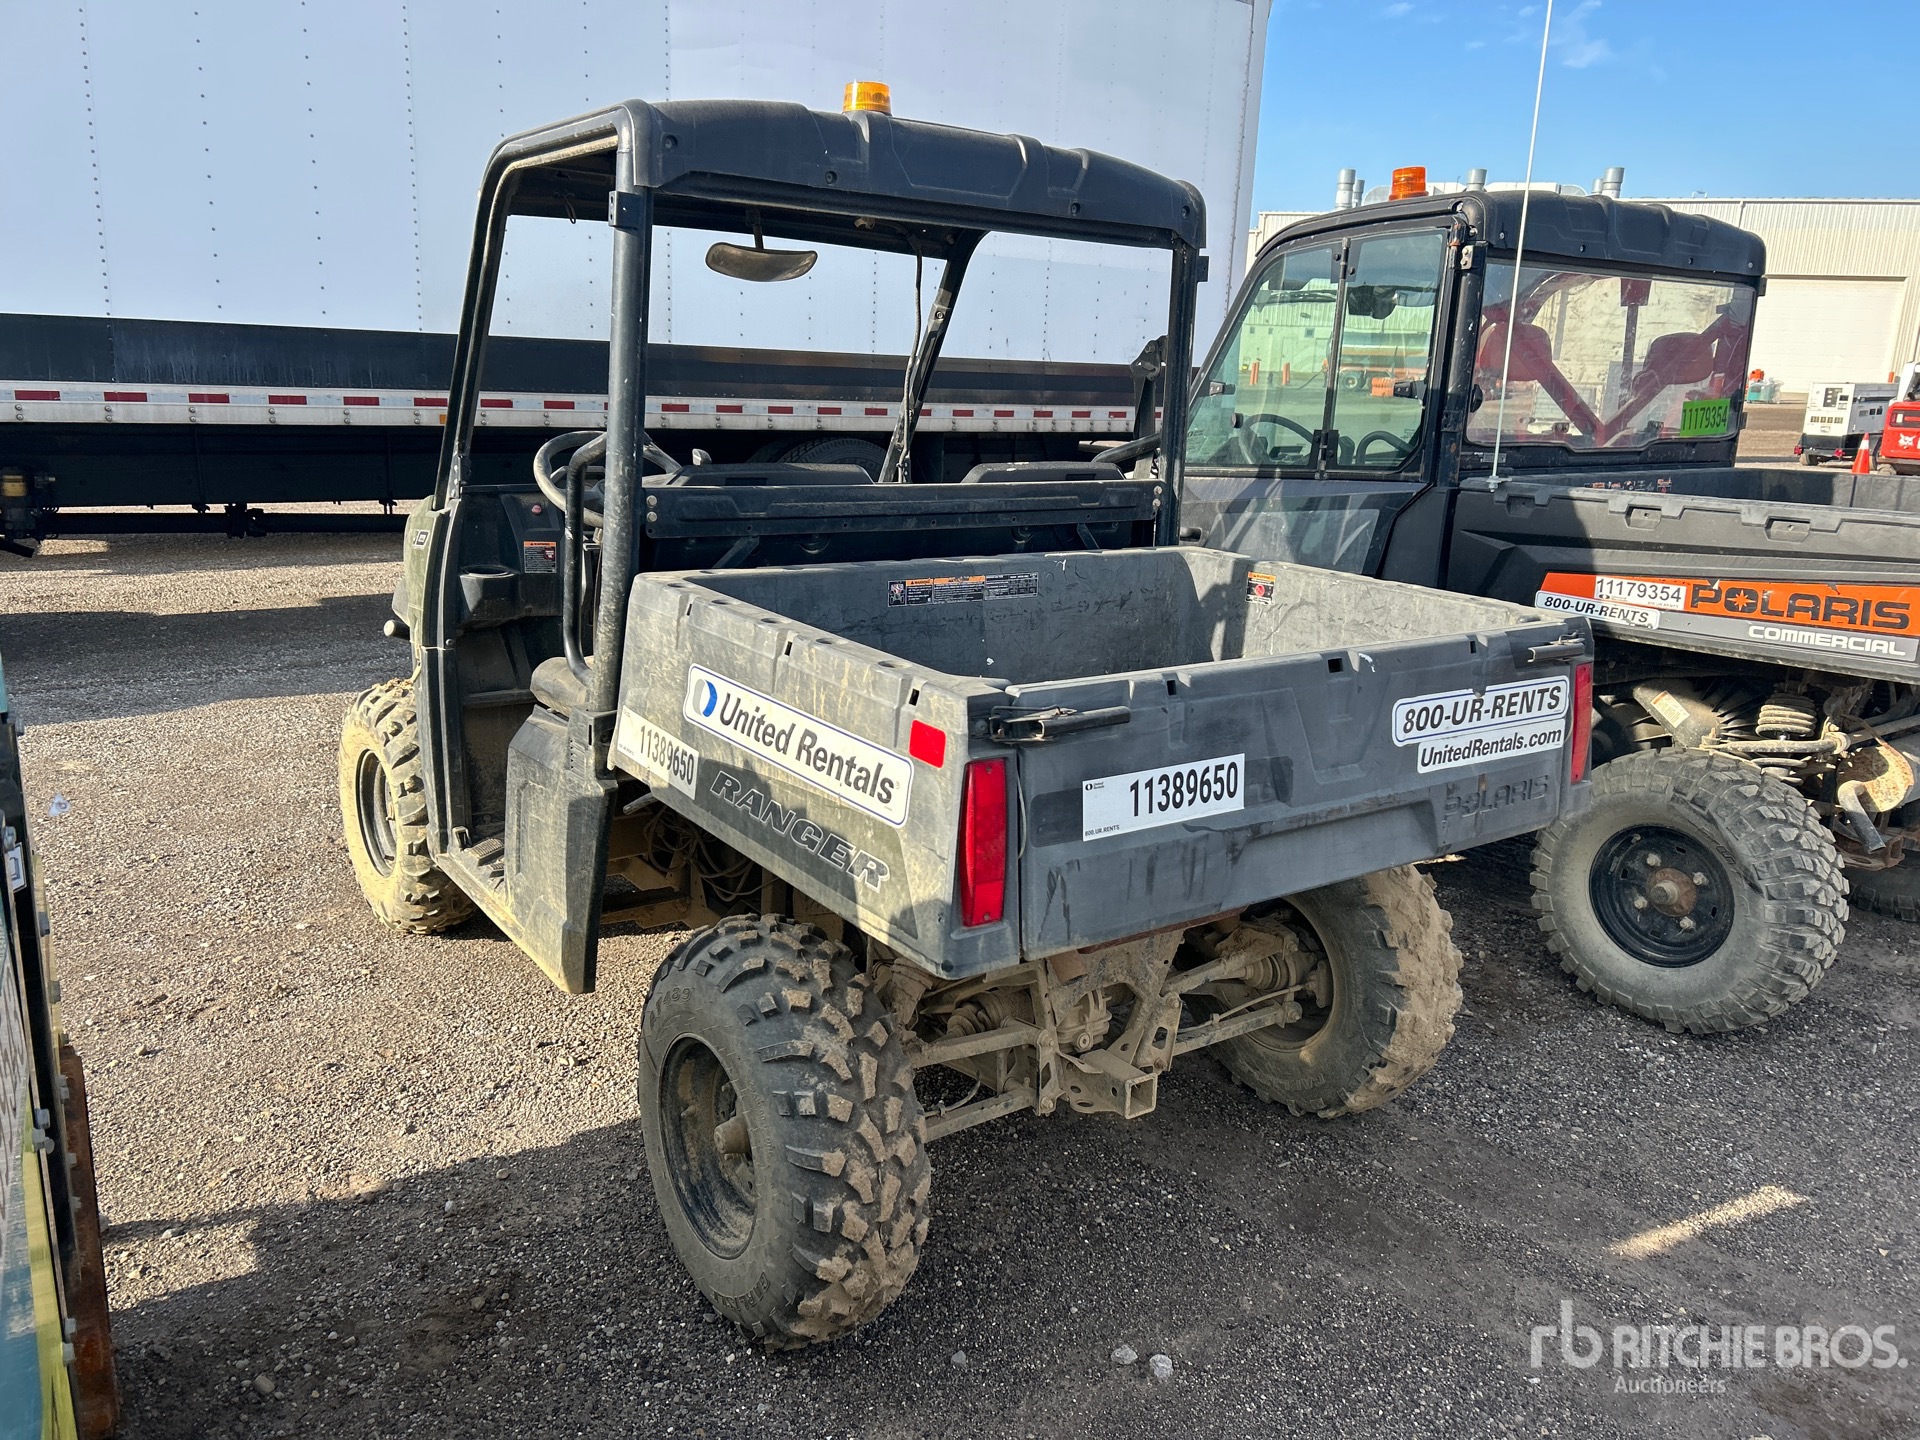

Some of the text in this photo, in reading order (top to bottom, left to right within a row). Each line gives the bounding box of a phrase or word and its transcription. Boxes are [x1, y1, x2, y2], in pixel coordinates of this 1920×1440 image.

[1682, 405, 1728, 431] 11179354
[1544, 596, 1650, 624] 800-UR-RENTS
[1597, 578, 1682, 603] 11179354
[1690, 583, 1911, 630] POLARIS
[1748, 626, 1907, 657] COMMERCIAL
[1402, 685, 1562, 734] 800-UR-RENTS
[641, 724, 695, 786] 11389650
[719, 692, 896, 804] United Rentals
[1420, 727, 1562, 768] UnitedRentals.com
[1129, 761, 1239, 817] 11389650
[1445, 774, 1549, 818] POLARIS
[709, 770, 891, 894] RANGER
